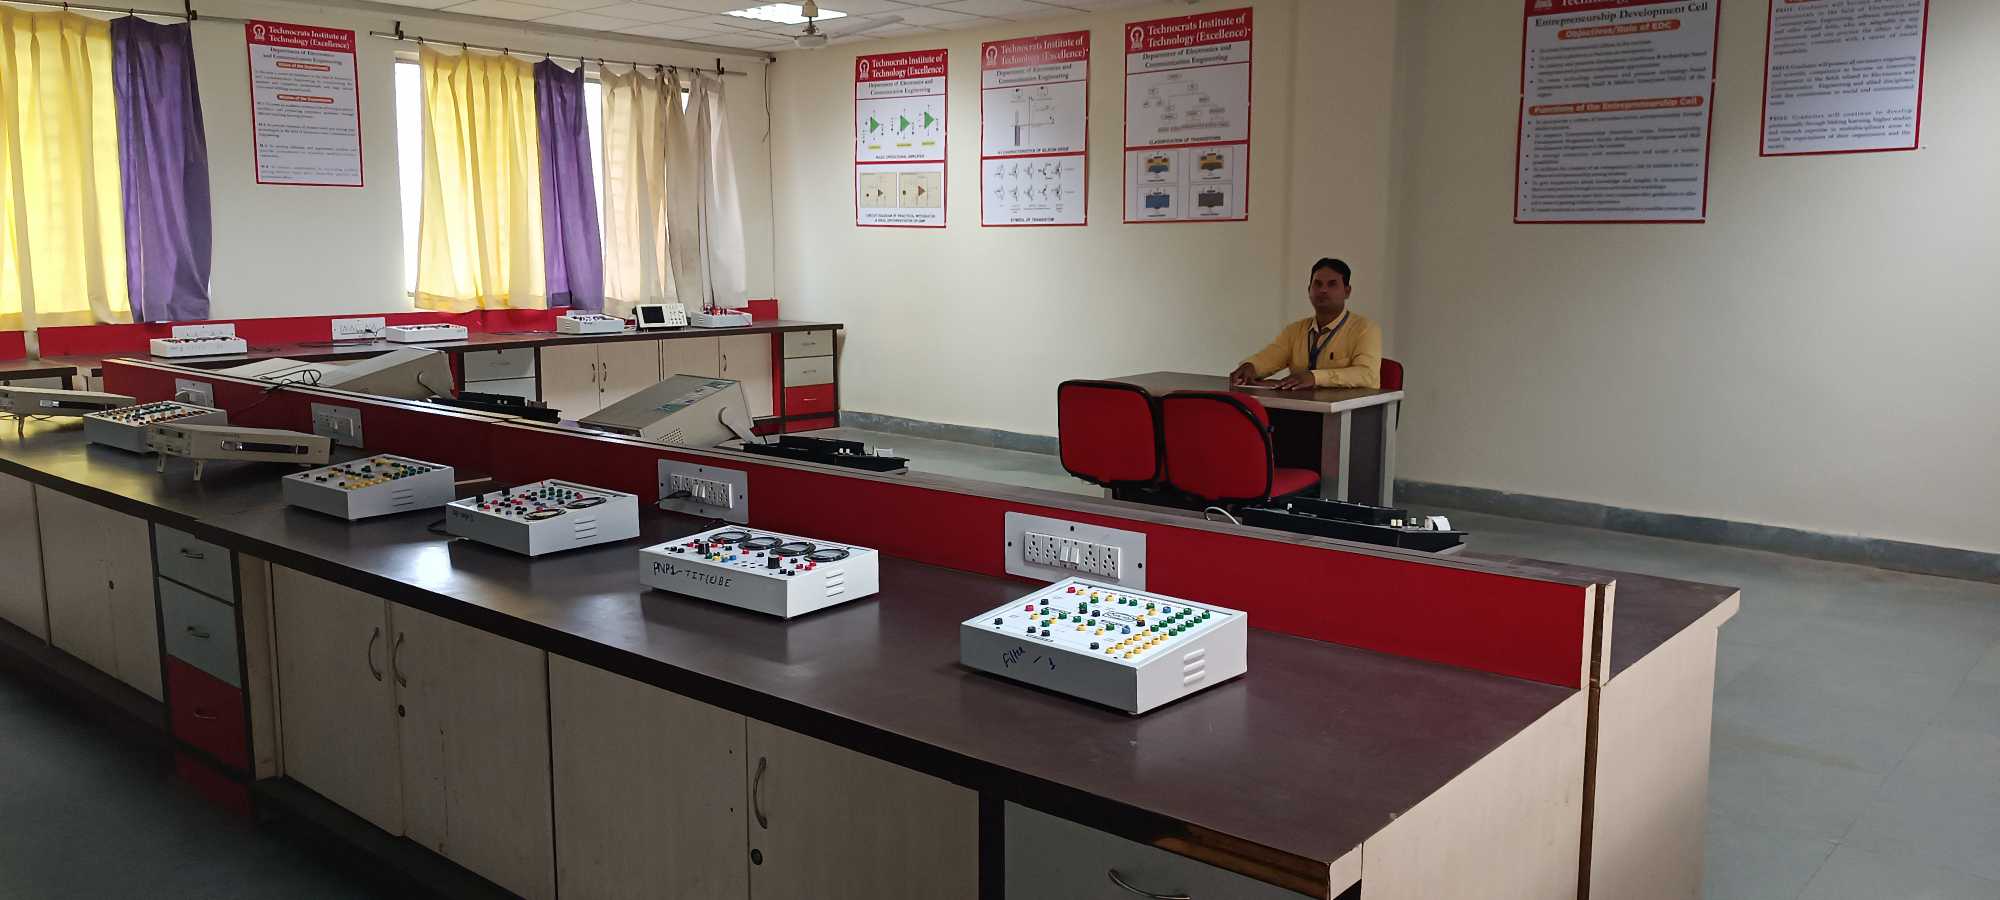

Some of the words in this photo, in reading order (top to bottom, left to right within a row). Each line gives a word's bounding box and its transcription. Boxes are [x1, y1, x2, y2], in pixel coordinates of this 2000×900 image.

[1536, 11, 1616, 27] Entrepreneurship
[1620, 6, 1685, 18] Development
[1688, 2, 1708, 12] Cell
[1148, 22, 1197, 36] Technocrats
[1199, 17, 1234, 30] Institute
[1236, 13, 1246, 24] of
[1651, 22, 1671, 32] EDC
[268, 26, 310, 37] Technocrats
[311, 30, 339, 40] Institute
[1149, 35, 1194, 48] Technology
[1196, 28, 1248, 41] (Excellence)
[269, 35, 309, 46] Technology
[309, 38, 350, 49] (Excellence)
[872, 58, 908, 68] Technocrats
[908, 55, 936, 64] Institute
[936, 53, 944, 62] of
[872, 68, 906, 78] Technology
[907, 64, 944, 76] (Excellence)
[1680, 97, 1696, 106] Cell
